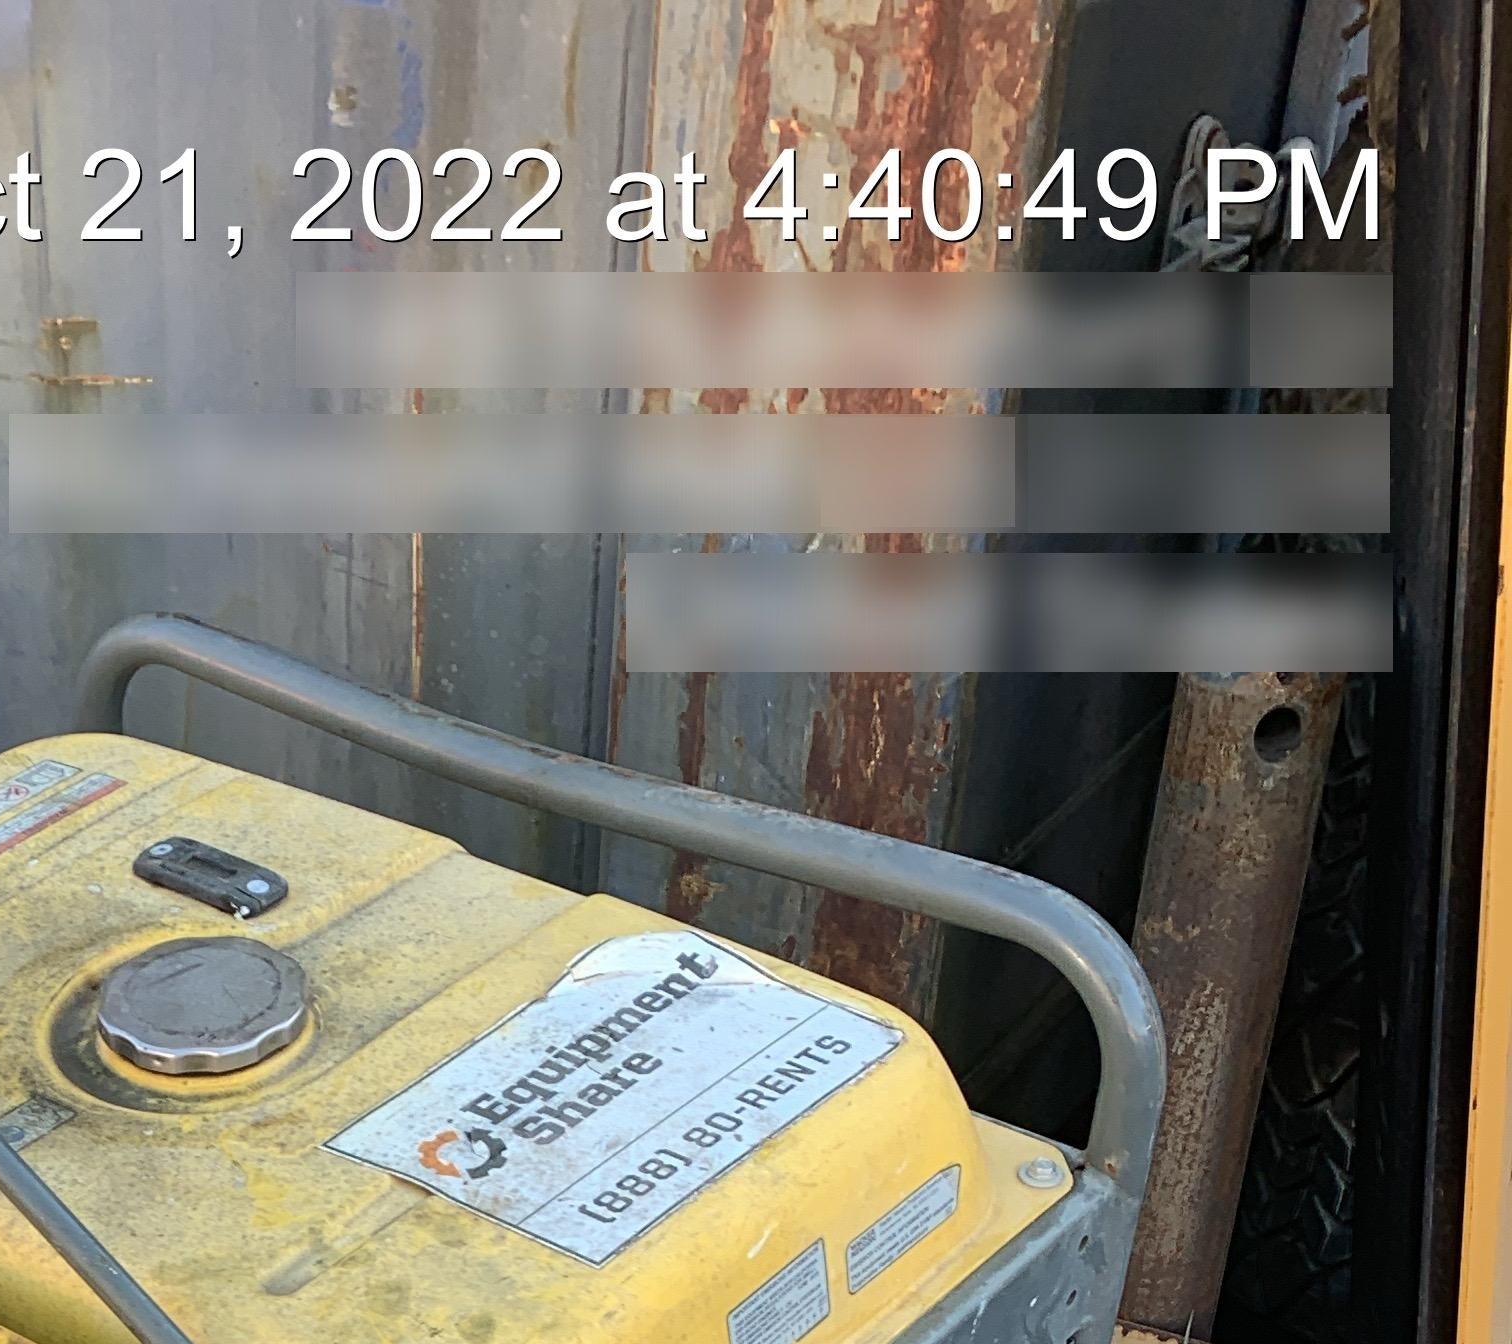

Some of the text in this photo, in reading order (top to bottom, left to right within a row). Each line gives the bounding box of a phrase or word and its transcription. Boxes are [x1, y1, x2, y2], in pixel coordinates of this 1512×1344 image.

[459, 951, 719, 1126] Equipment
[681, 1034, 852, 1148] 80-RENTS
[512, 1051, 663, 1145] Share
